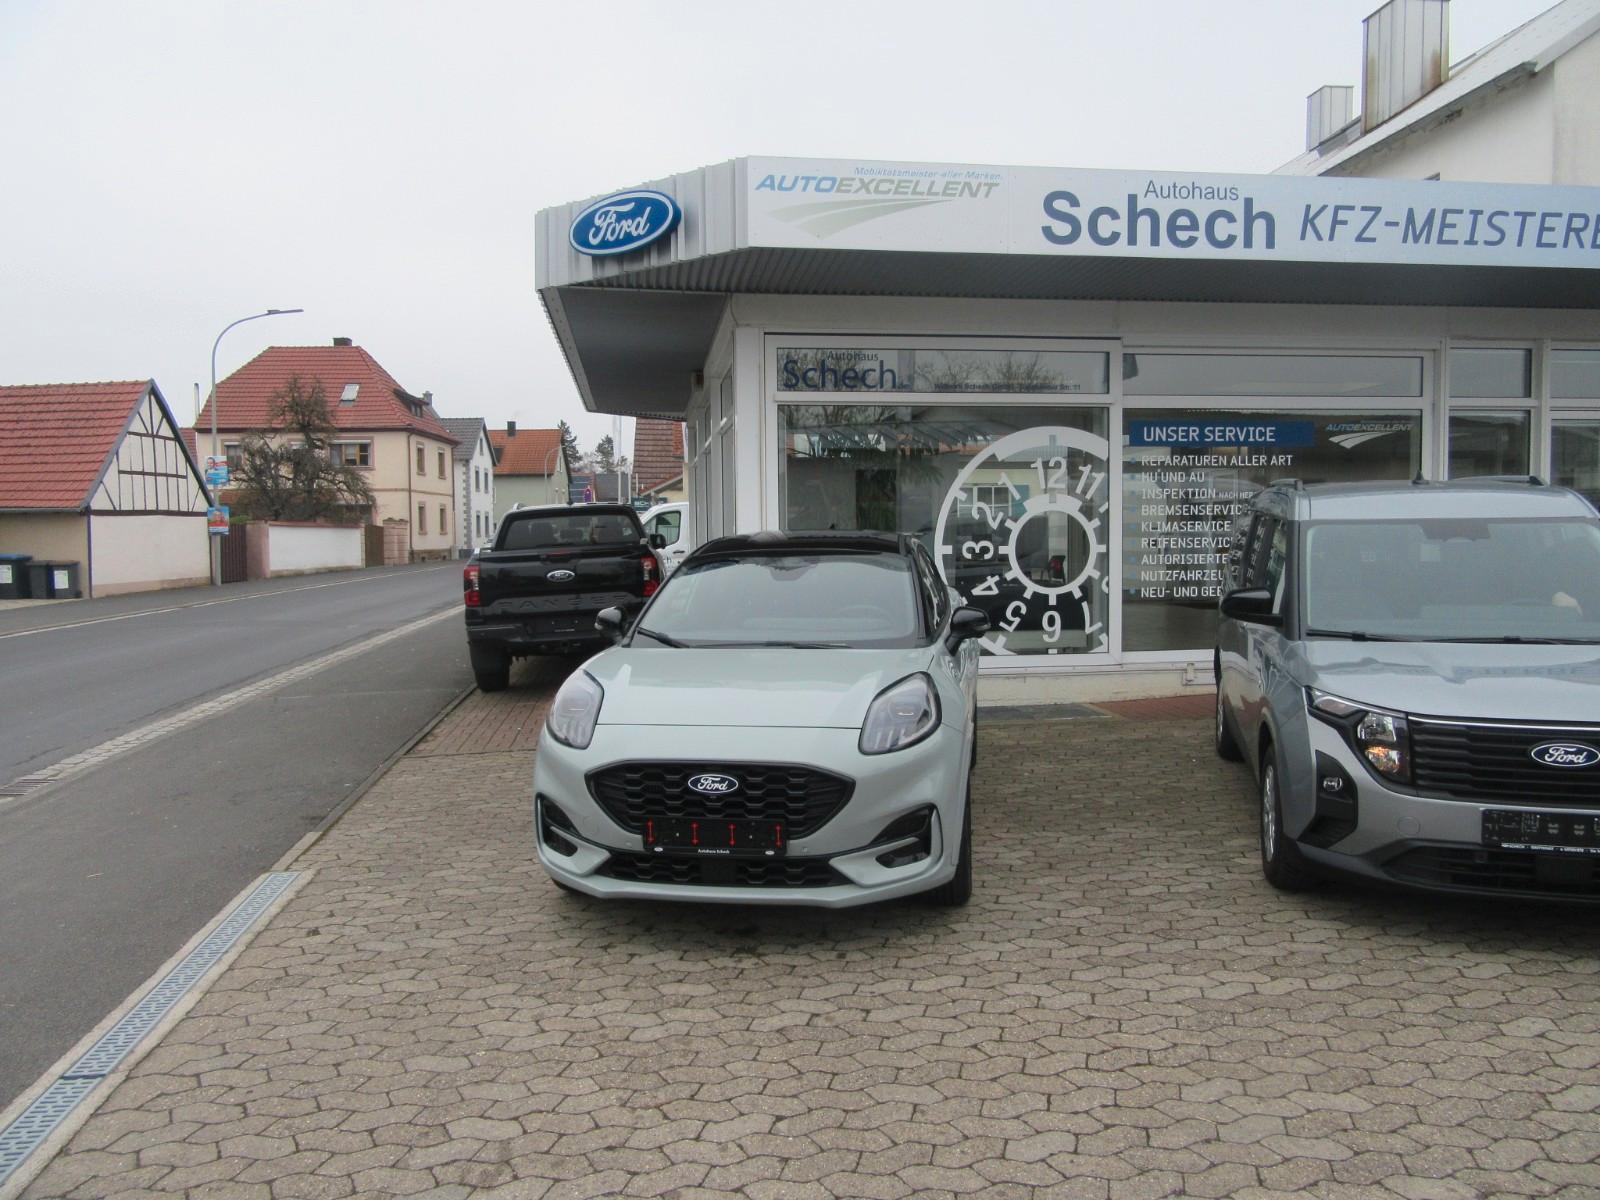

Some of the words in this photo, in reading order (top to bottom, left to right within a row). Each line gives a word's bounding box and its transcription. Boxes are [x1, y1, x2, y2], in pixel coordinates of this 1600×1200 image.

[754, 174, 1000, 199] AUTOEXCELLENT
[1143, 180, 1239, 201] Autohaus
[588, 202, 652, 246] Ford
[1041, 189, 1276, 249] Schech
[827, 350, 879, 361] Autohaus
[783, 359, 897, 389] Schech
[1325, 423, 1414, 431] AUTOEXCELLENT
[1143, 426, 1199, 442] UNSER
[1204, 426, 1276, 442] SERVICE
[1141, 455, 1227, 466] REPARATUREN
[1230, 455, 1267, 466] ALLER
[1270, 455, 1293, 466] ART
[1031, 456, 1067, 490] 12
[1141, 471, 1158, 482] HU
[1161, 471, 1186, 482] UND
[1188, 471, 1205, 482] AU
[1141, 488, 1216, 499] INSPEKTION
[1141, 521, 1232, 532] KLIMASERVICE
[1141, 537, 1233, 549] REIFENSERVIC
[1141, 586, 1171, 598] NEU-
[1173, 586, 1198, 598] UND
